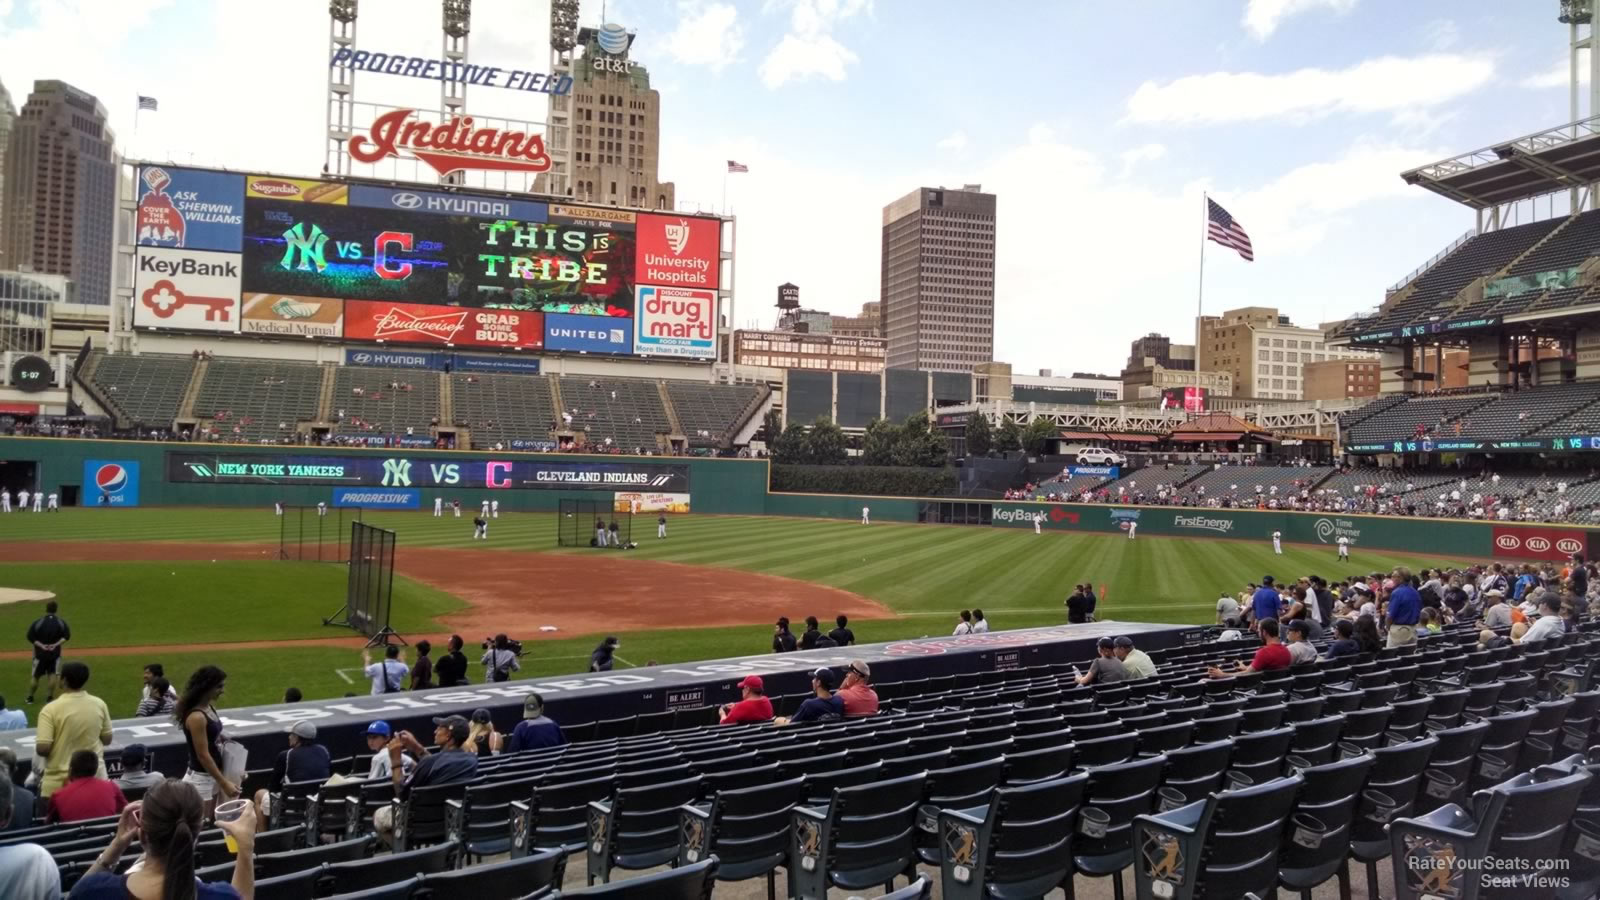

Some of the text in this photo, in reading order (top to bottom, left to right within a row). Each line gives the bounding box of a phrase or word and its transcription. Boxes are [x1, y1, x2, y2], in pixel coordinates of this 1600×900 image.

[329, 47, 573, 95] PROGRESSIVE FIELD
[593, 55, 631, 74] at&t
[349, 108, 551, 175] Indians
[252, 181, 300, 195] Sugardale
[173, 191, 198, 200] ASK
[178, 201, 232, 214] SHERWIN
[428, 197, 509, 216] HYUNDAI
[185, 212, 243, 225] WILLIAMS
[608, 211, 631, 221] GAME
[573, 219, 587, 227] JULY
[598, 221, 612, 229] FOX
[479, 221, 586, 252] THIS
[335, 241, 362, 260] VS
[374, 231, 413, 281] C
[140, 255, 238, 278] KeyBank
[478, 254, 607, 284] TRIBE
[644, 254, 710, 272] University
[647, 269, 707, 284] Hospitals
[661, 289, 693, 297] DISCOUNT
[646, 289, 701, 323] drug
[373, 313, 465, 332] Budweiser
[475, 313, 520, 325] GRAB
[248, 321, 336, 336] Medical Mutual
[482, 323, 513, 332] SOME
[550, 328, 607, 340] UNITED
[650, 320, 712, 340] mart
[475, 330, 519, 342] BUDS
[680, 347, 715, 356] Drugstore
[374, 355, 425, 365] HYUNDAI
[1406, 443, 1416, 451] VS
[1569, 439, 1582, 448] VS
[218, 463, 247, 474] NEW
[250, 464, 285, 475] YORK
[288, 465, 344, 477] YANKEES
[430, 463, 460, 484] VS
[486, 461, 512, 488] C
[536, 471, 600, 482] CLEVELAND
[603, 473, 648, 483] INDIANS
[98, 495, 123, 503] ppsi
[341, 493, 411, 504] PROGRESSIVE
[1174, 516, 1233, 530] FirstEnergy
[1336, 519, 1352, 527] Time
[1335, 528, 1360, 537] Warner
[1499, 537, 1578, 551] KIA KIA KIA
[680, 692, 702, 701] ALERT
